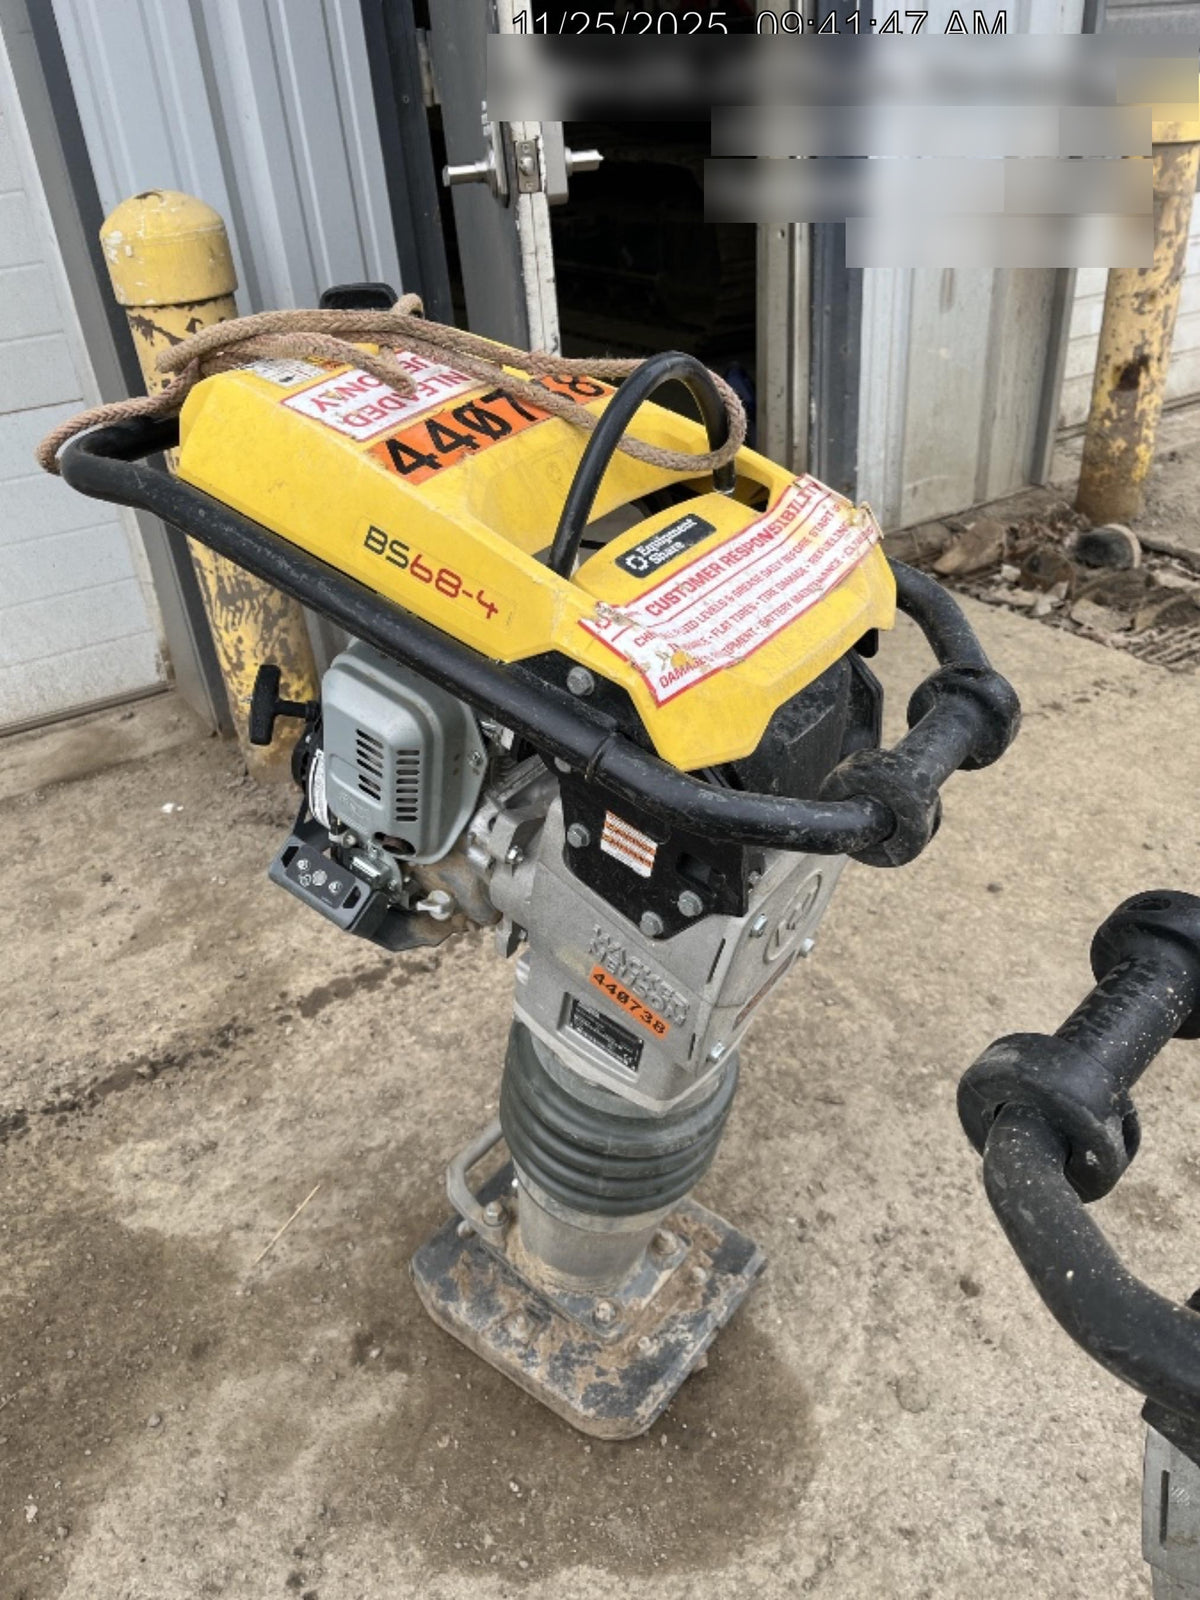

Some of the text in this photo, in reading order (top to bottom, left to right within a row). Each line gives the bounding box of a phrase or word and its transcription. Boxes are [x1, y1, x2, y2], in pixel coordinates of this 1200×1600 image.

[636, 518, 697, 555] Equipment
[645, 482, 822, 617] CUSTOMER RESPONSIBILITY
[649, 541, 685, 564] Share
[698, 597, 729, 623] LEVELS
[732, 573, 764, 597] GREASE
[781, 536, 812, 564] BEFORE
[809, 509, 835, 538] START
[363, 525, 499, 619] BS68-4
[711, 621, 732, 639] FLAT
[729, 602, 758, 624] TIRES
[757, 585, 779, 604] TIRE
[758, 600, 794, 628] BATTERY
[593, 924, 690, 1011] WACKER
[594, 973, 666, 1034] 440738
